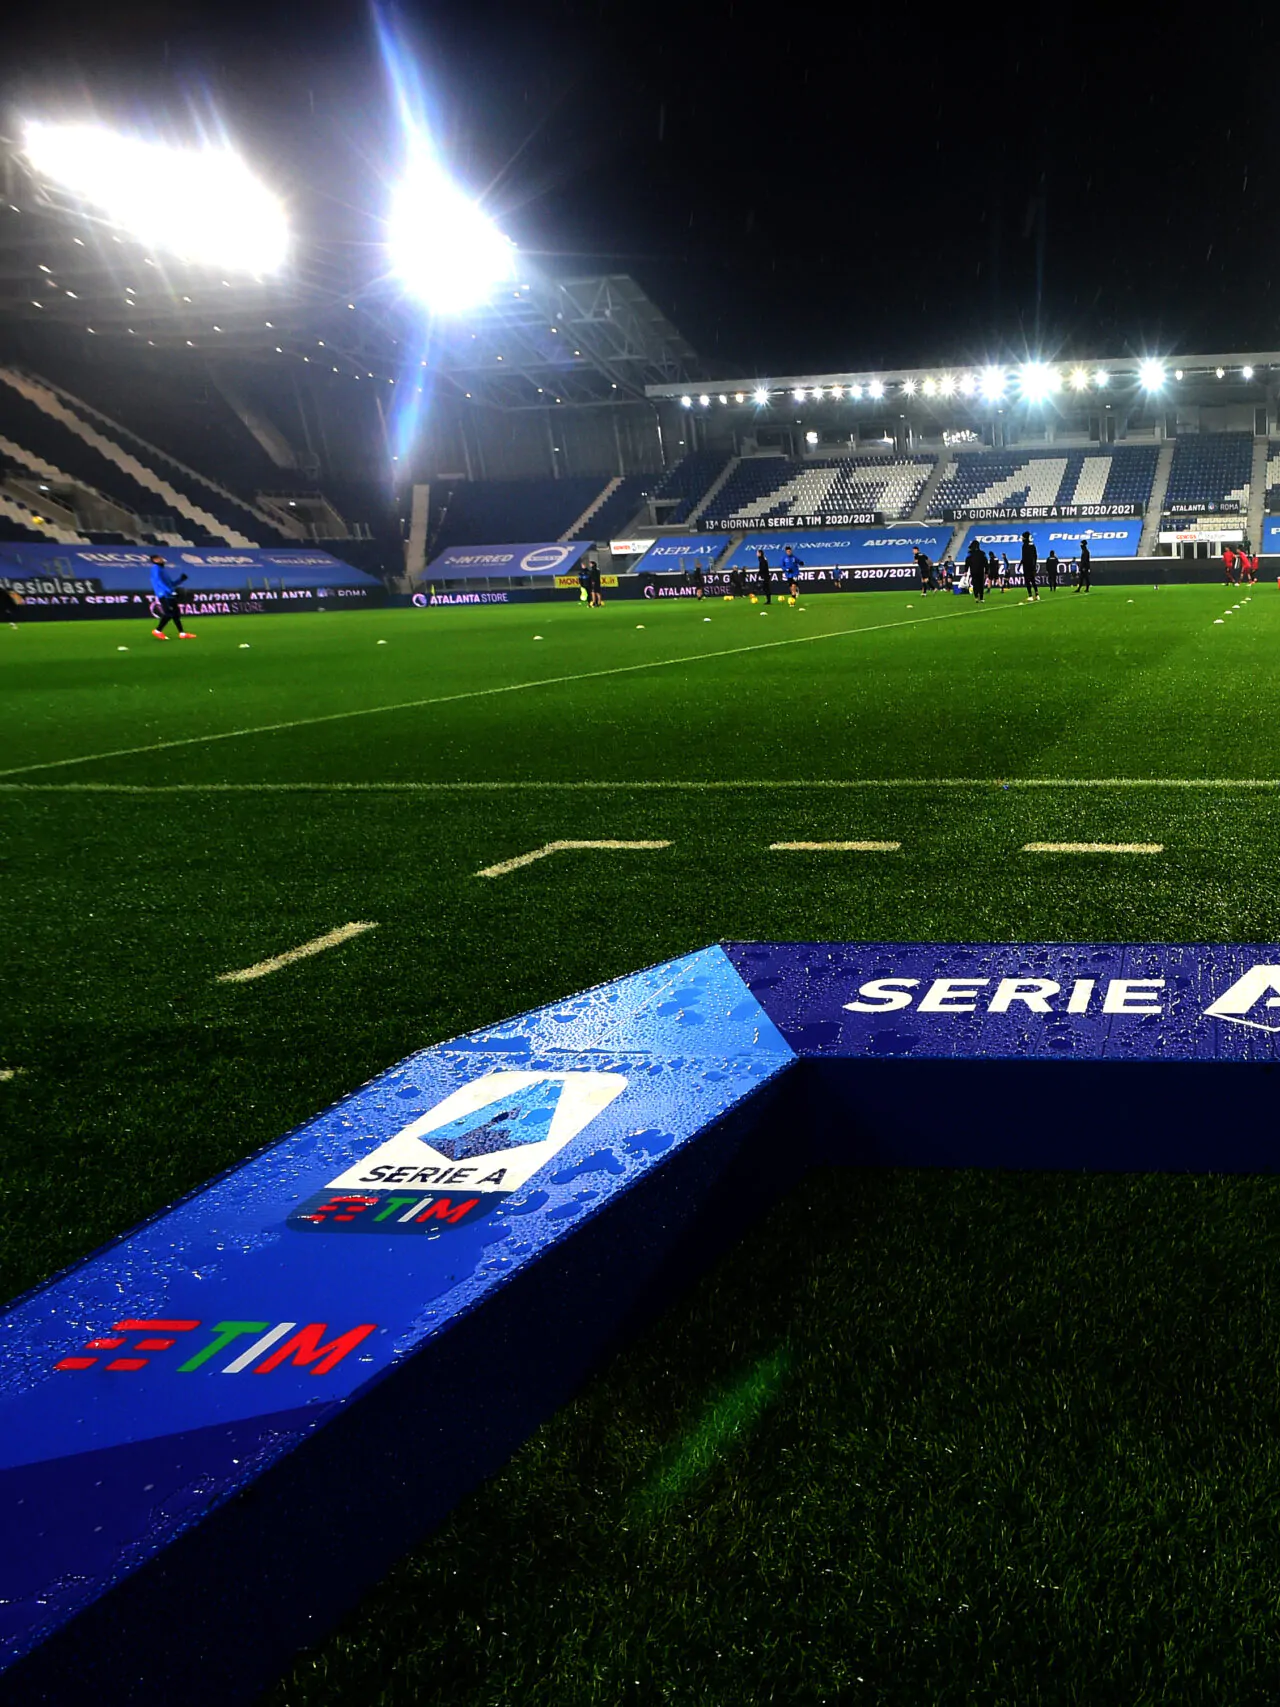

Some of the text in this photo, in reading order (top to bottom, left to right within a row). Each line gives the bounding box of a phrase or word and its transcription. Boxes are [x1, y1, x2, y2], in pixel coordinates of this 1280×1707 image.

[969, 508, 1017, 519] GIORNATA
[1020, 507, 1048, 518] SERIE
[1050, 507, 1058, 517] A
[1061, 506, 1078, 516] TIM
[1081, 504, 1135, 516] 2020/2021
[1171, 503, 1239, 512] ATALANTA ROMA
[721, 518, 766, 529] GIORNATA
[768, 517, 794, 527] SERIE
[796, 516, 804, 526] A
[805, 515, 822, 525] TIM
[825, 514, 875, 525] 2020/2021
[1049, 528, 1129, 542] Plus500
[651, 545, 718, 557] REPLAY
[817, 569, 827, 579] A
[854, 567, 917, 579] 2020/2021
[250, 590, 313, 601] ATALANTA
[704, 585, 731, 597] STORE
[430, 592, 509, 605] ATALANTA STORE
[232, 601, 265, 614] STORE
[842, 977, 1168, 1014] SERIE
[359, 1165, 508, 1185] SERIE A
[373, 1196, 481, 1223] TIM
[175, 1320, 379, 1375] TIM
